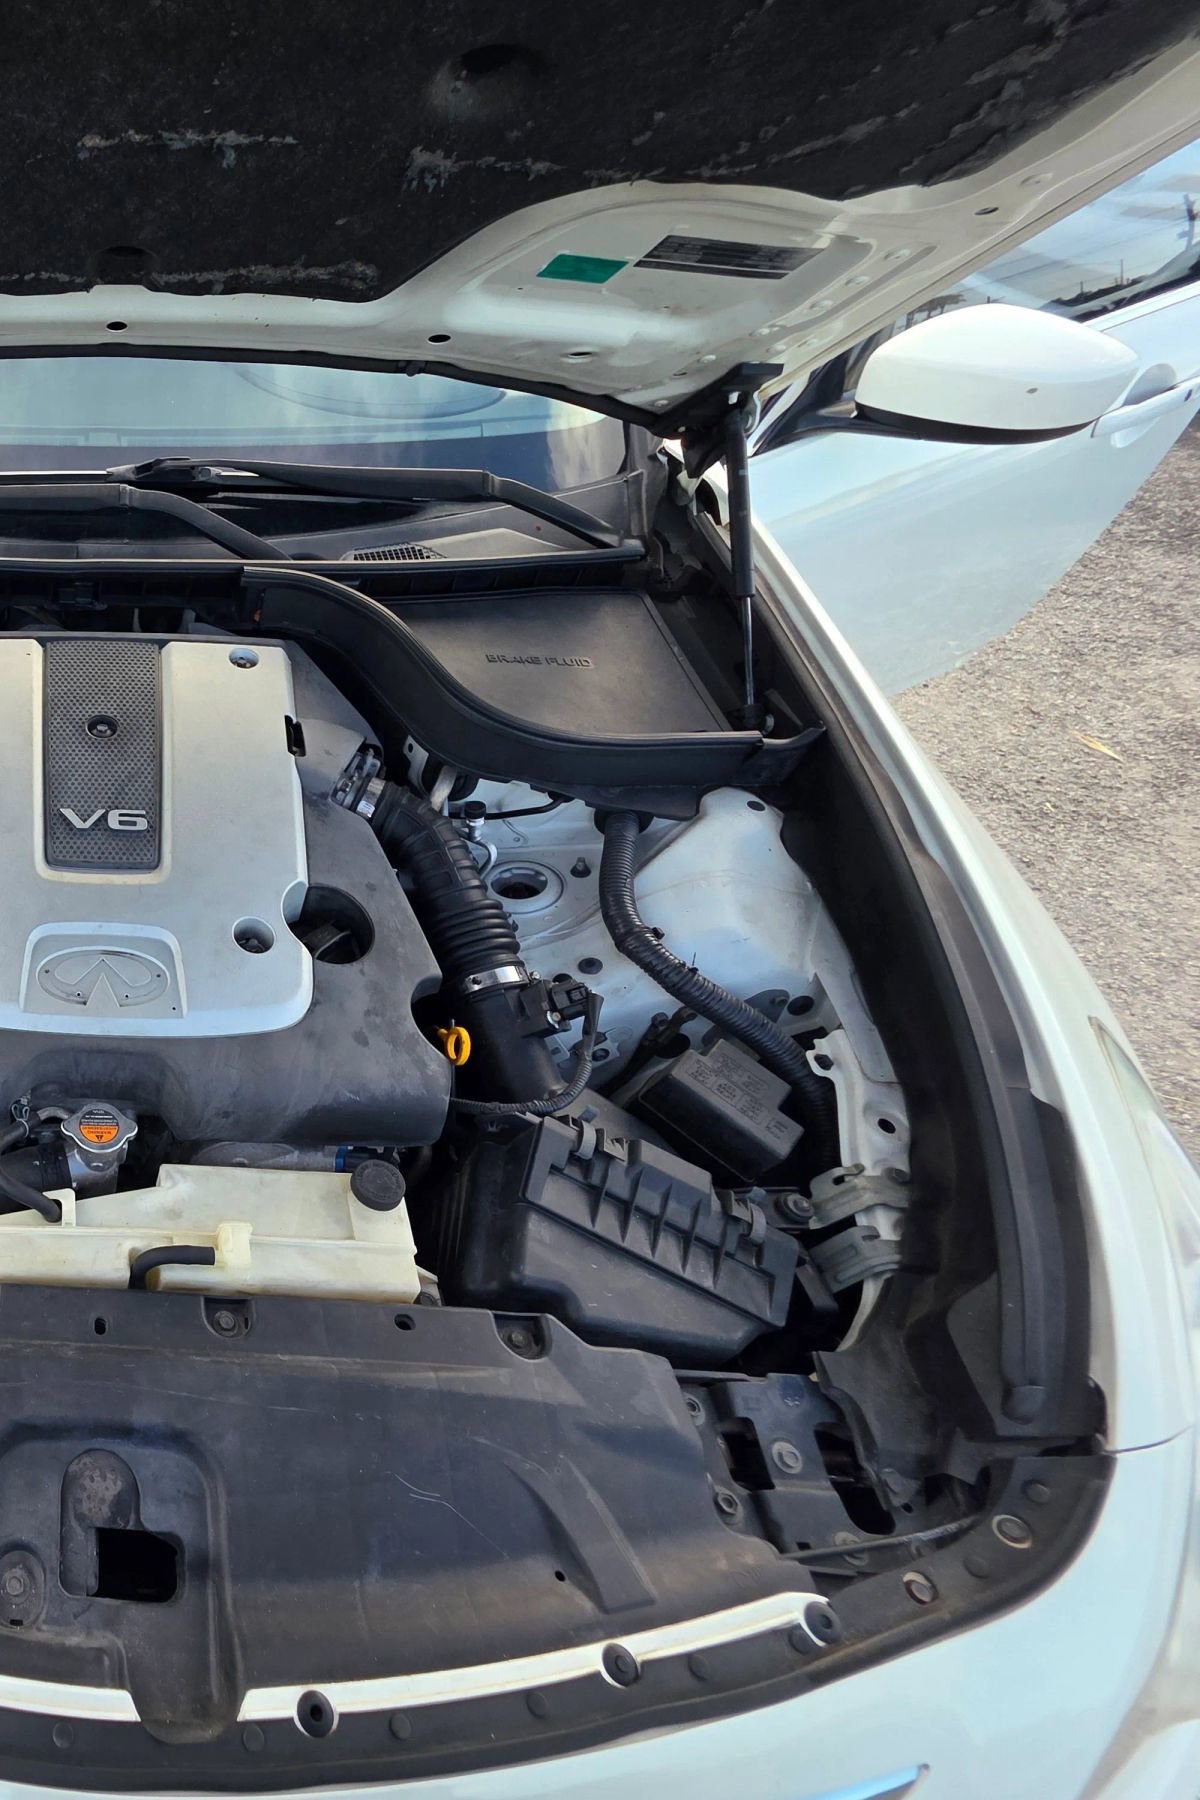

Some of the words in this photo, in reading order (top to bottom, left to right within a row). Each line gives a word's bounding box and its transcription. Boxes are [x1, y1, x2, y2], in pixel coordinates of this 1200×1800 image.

[485, 653, 542, 665] BRAKE
[545, 656, 594, 668] FLUID
[59, 807, 148, 832] V6
